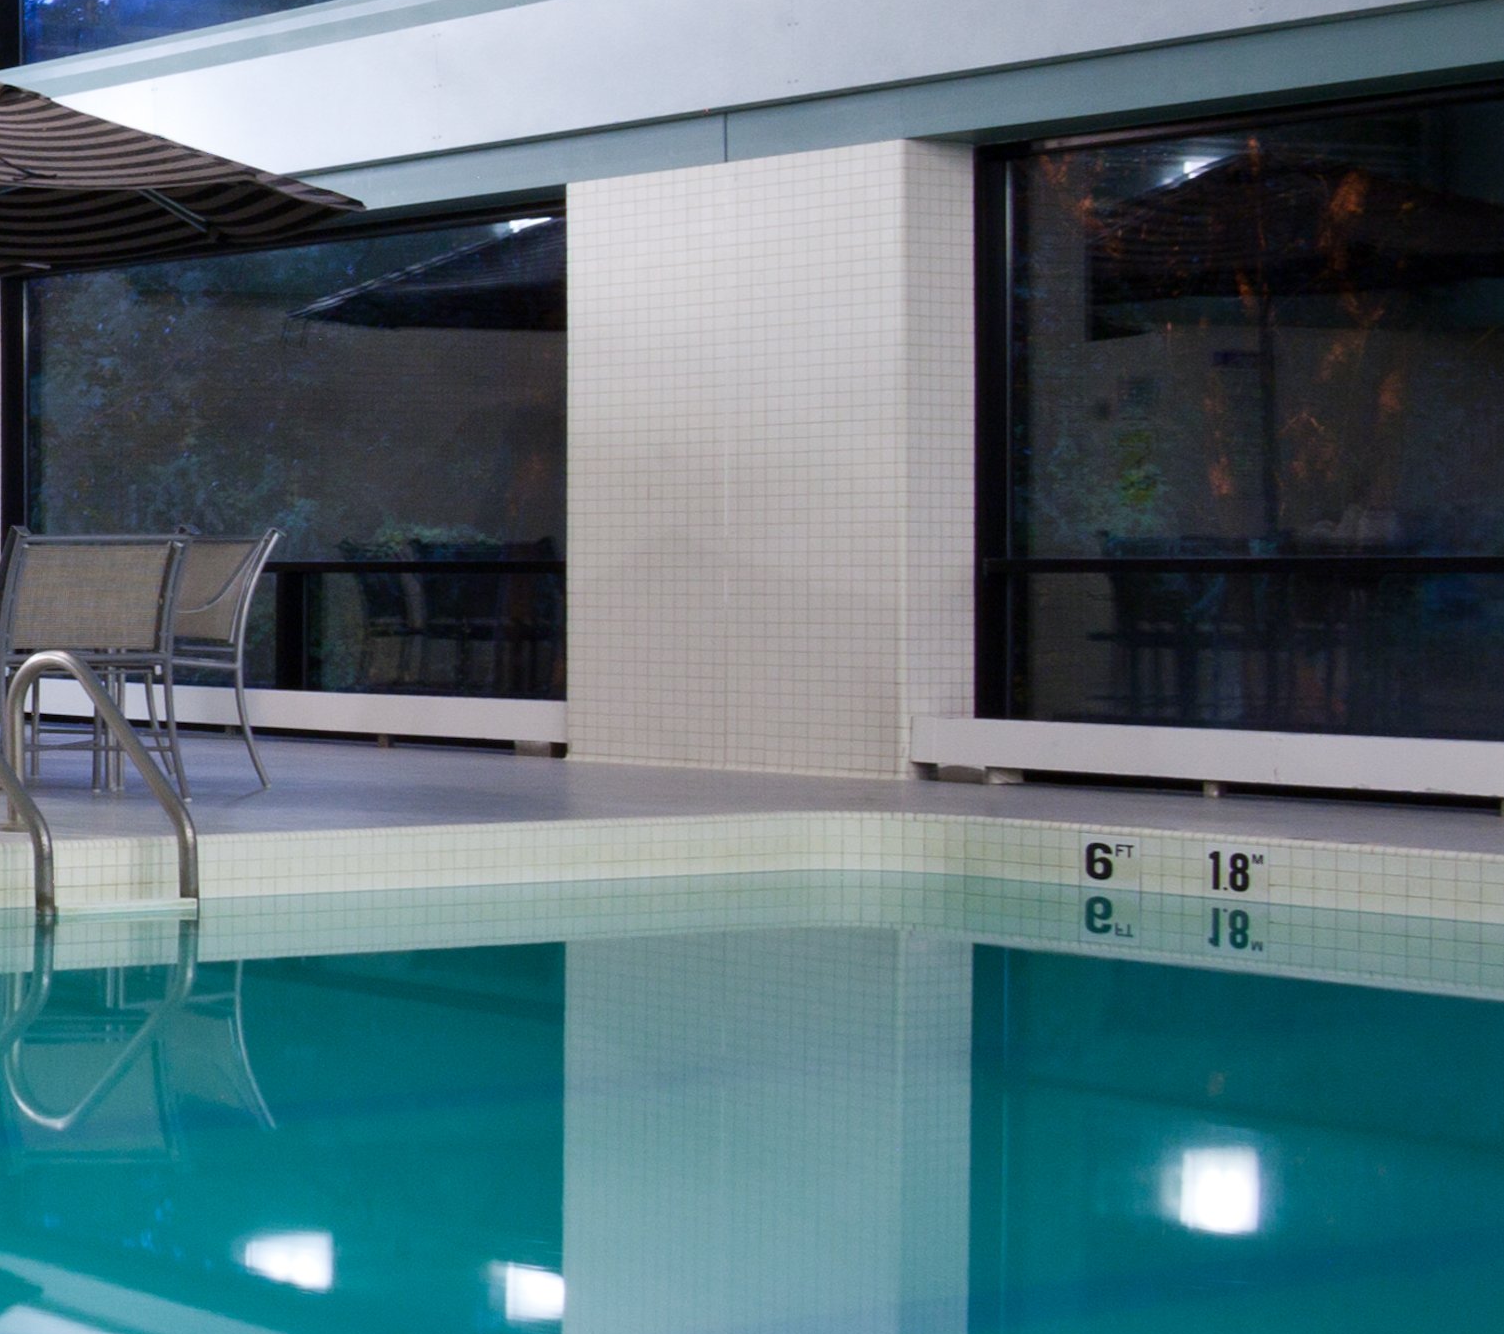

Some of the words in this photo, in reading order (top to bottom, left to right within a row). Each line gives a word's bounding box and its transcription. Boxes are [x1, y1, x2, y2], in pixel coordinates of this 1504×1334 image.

[1085, 842, 1113, 880] 6
[1115, 844, 1134, 858] FT
[1208, 851, 1249, 892] 1.8
[1252, 854, 1264, 865] M
